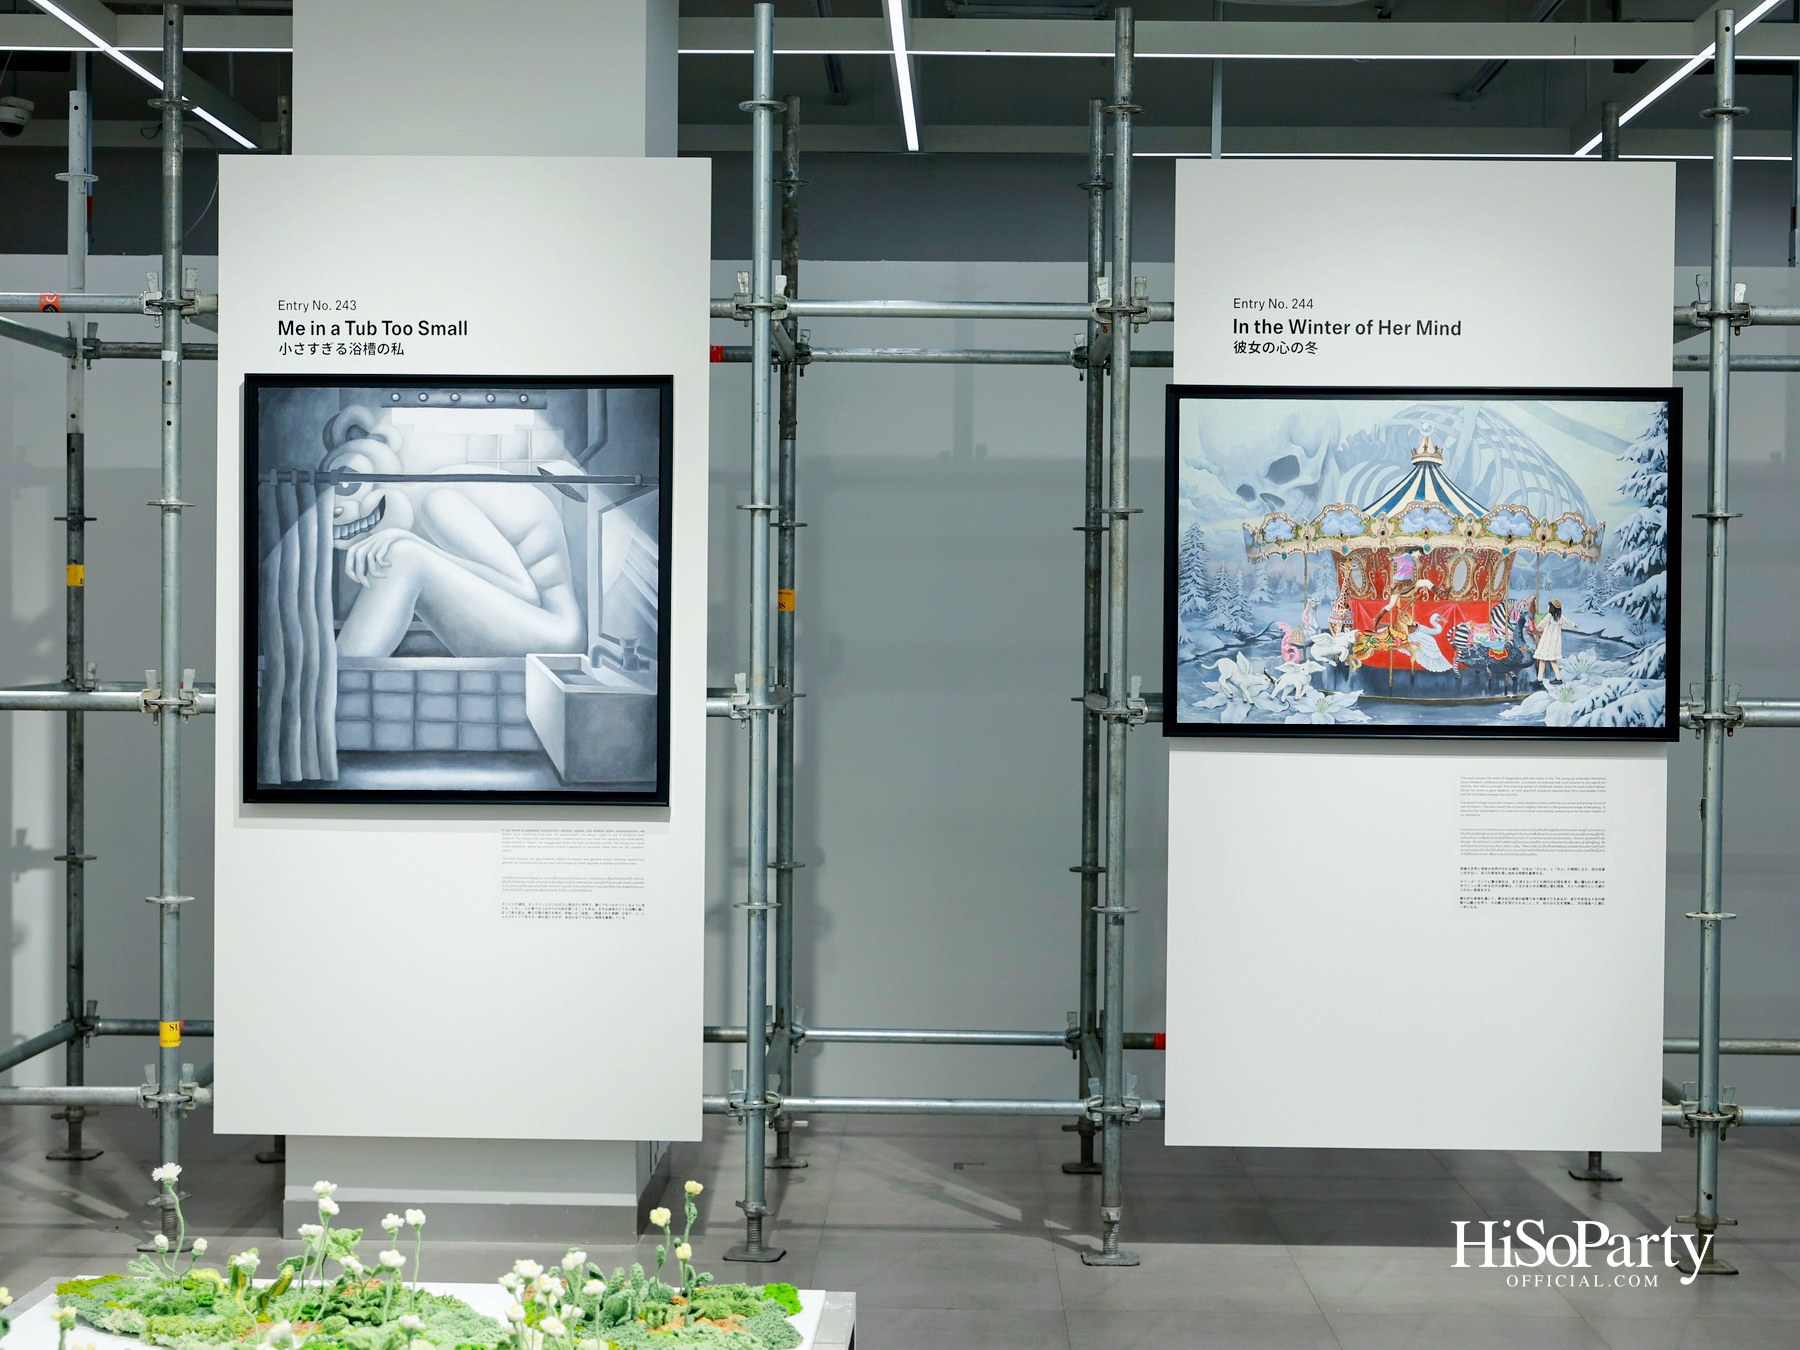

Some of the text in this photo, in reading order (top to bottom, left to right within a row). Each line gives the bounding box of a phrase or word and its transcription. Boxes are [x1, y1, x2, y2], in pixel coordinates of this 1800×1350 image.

[278, 300, 357, 314] Entry No. 243
[1233, 298, 1314, 312] Entry No. 244
[278, 320, 468, 336] Me in a Tub Too Small
[1233, 319, 1462, 337] In the Winter of Her Mind
[278, 342, 405, 356] 小さすぎる浴槽の私
[1233, 340, 1319, 355] 彼女の心の冬
